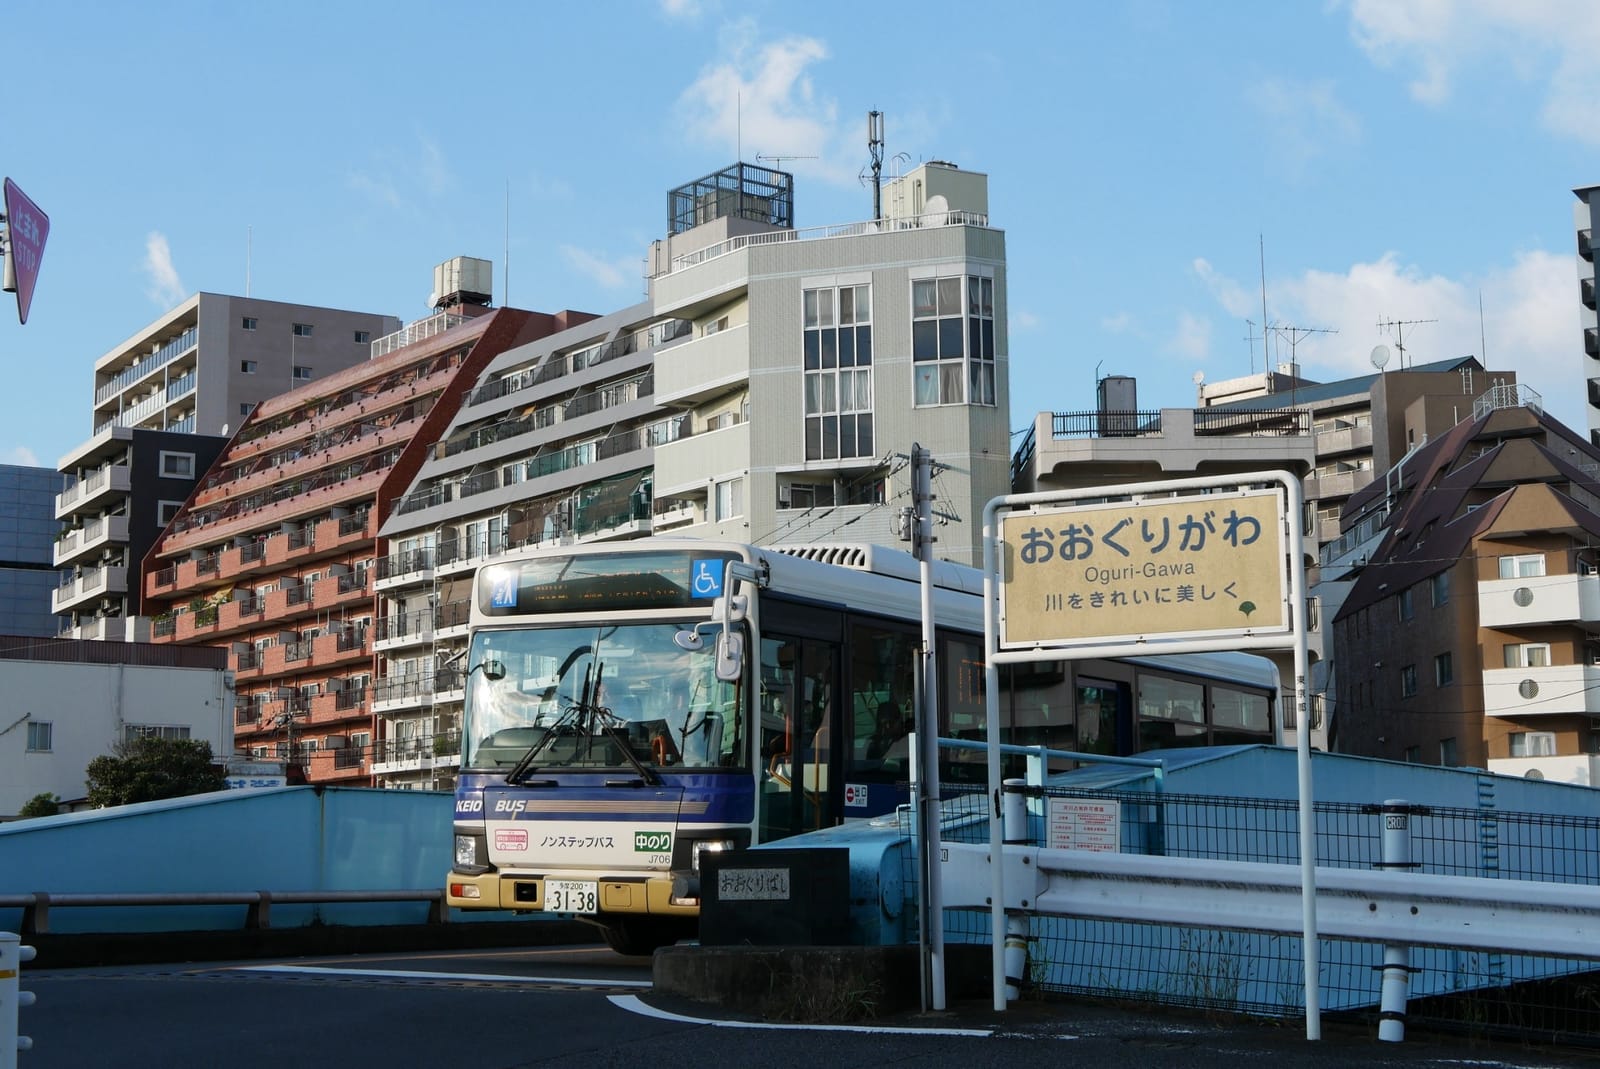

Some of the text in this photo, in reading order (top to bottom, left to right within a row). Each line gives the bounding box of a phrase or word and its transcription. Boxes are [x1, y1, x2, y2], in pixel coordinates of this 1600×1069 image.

[17, 241, 36, 272] STOP
[1020, 509, 1262, 564] おおぐりがわ
[1084, 562, 1196, 585] Oguri-Gawa
[1045, 581, 1238, 612] 川をきれいに美しく
[455, 800, 527, 813] KEIO BUS
[540, 836, 614, 848] ノンステップバス
[635, 833, 671, 850] 中のり
[648, 854, 671, 864] J706
[553, 890, 595, 911] 31-38
